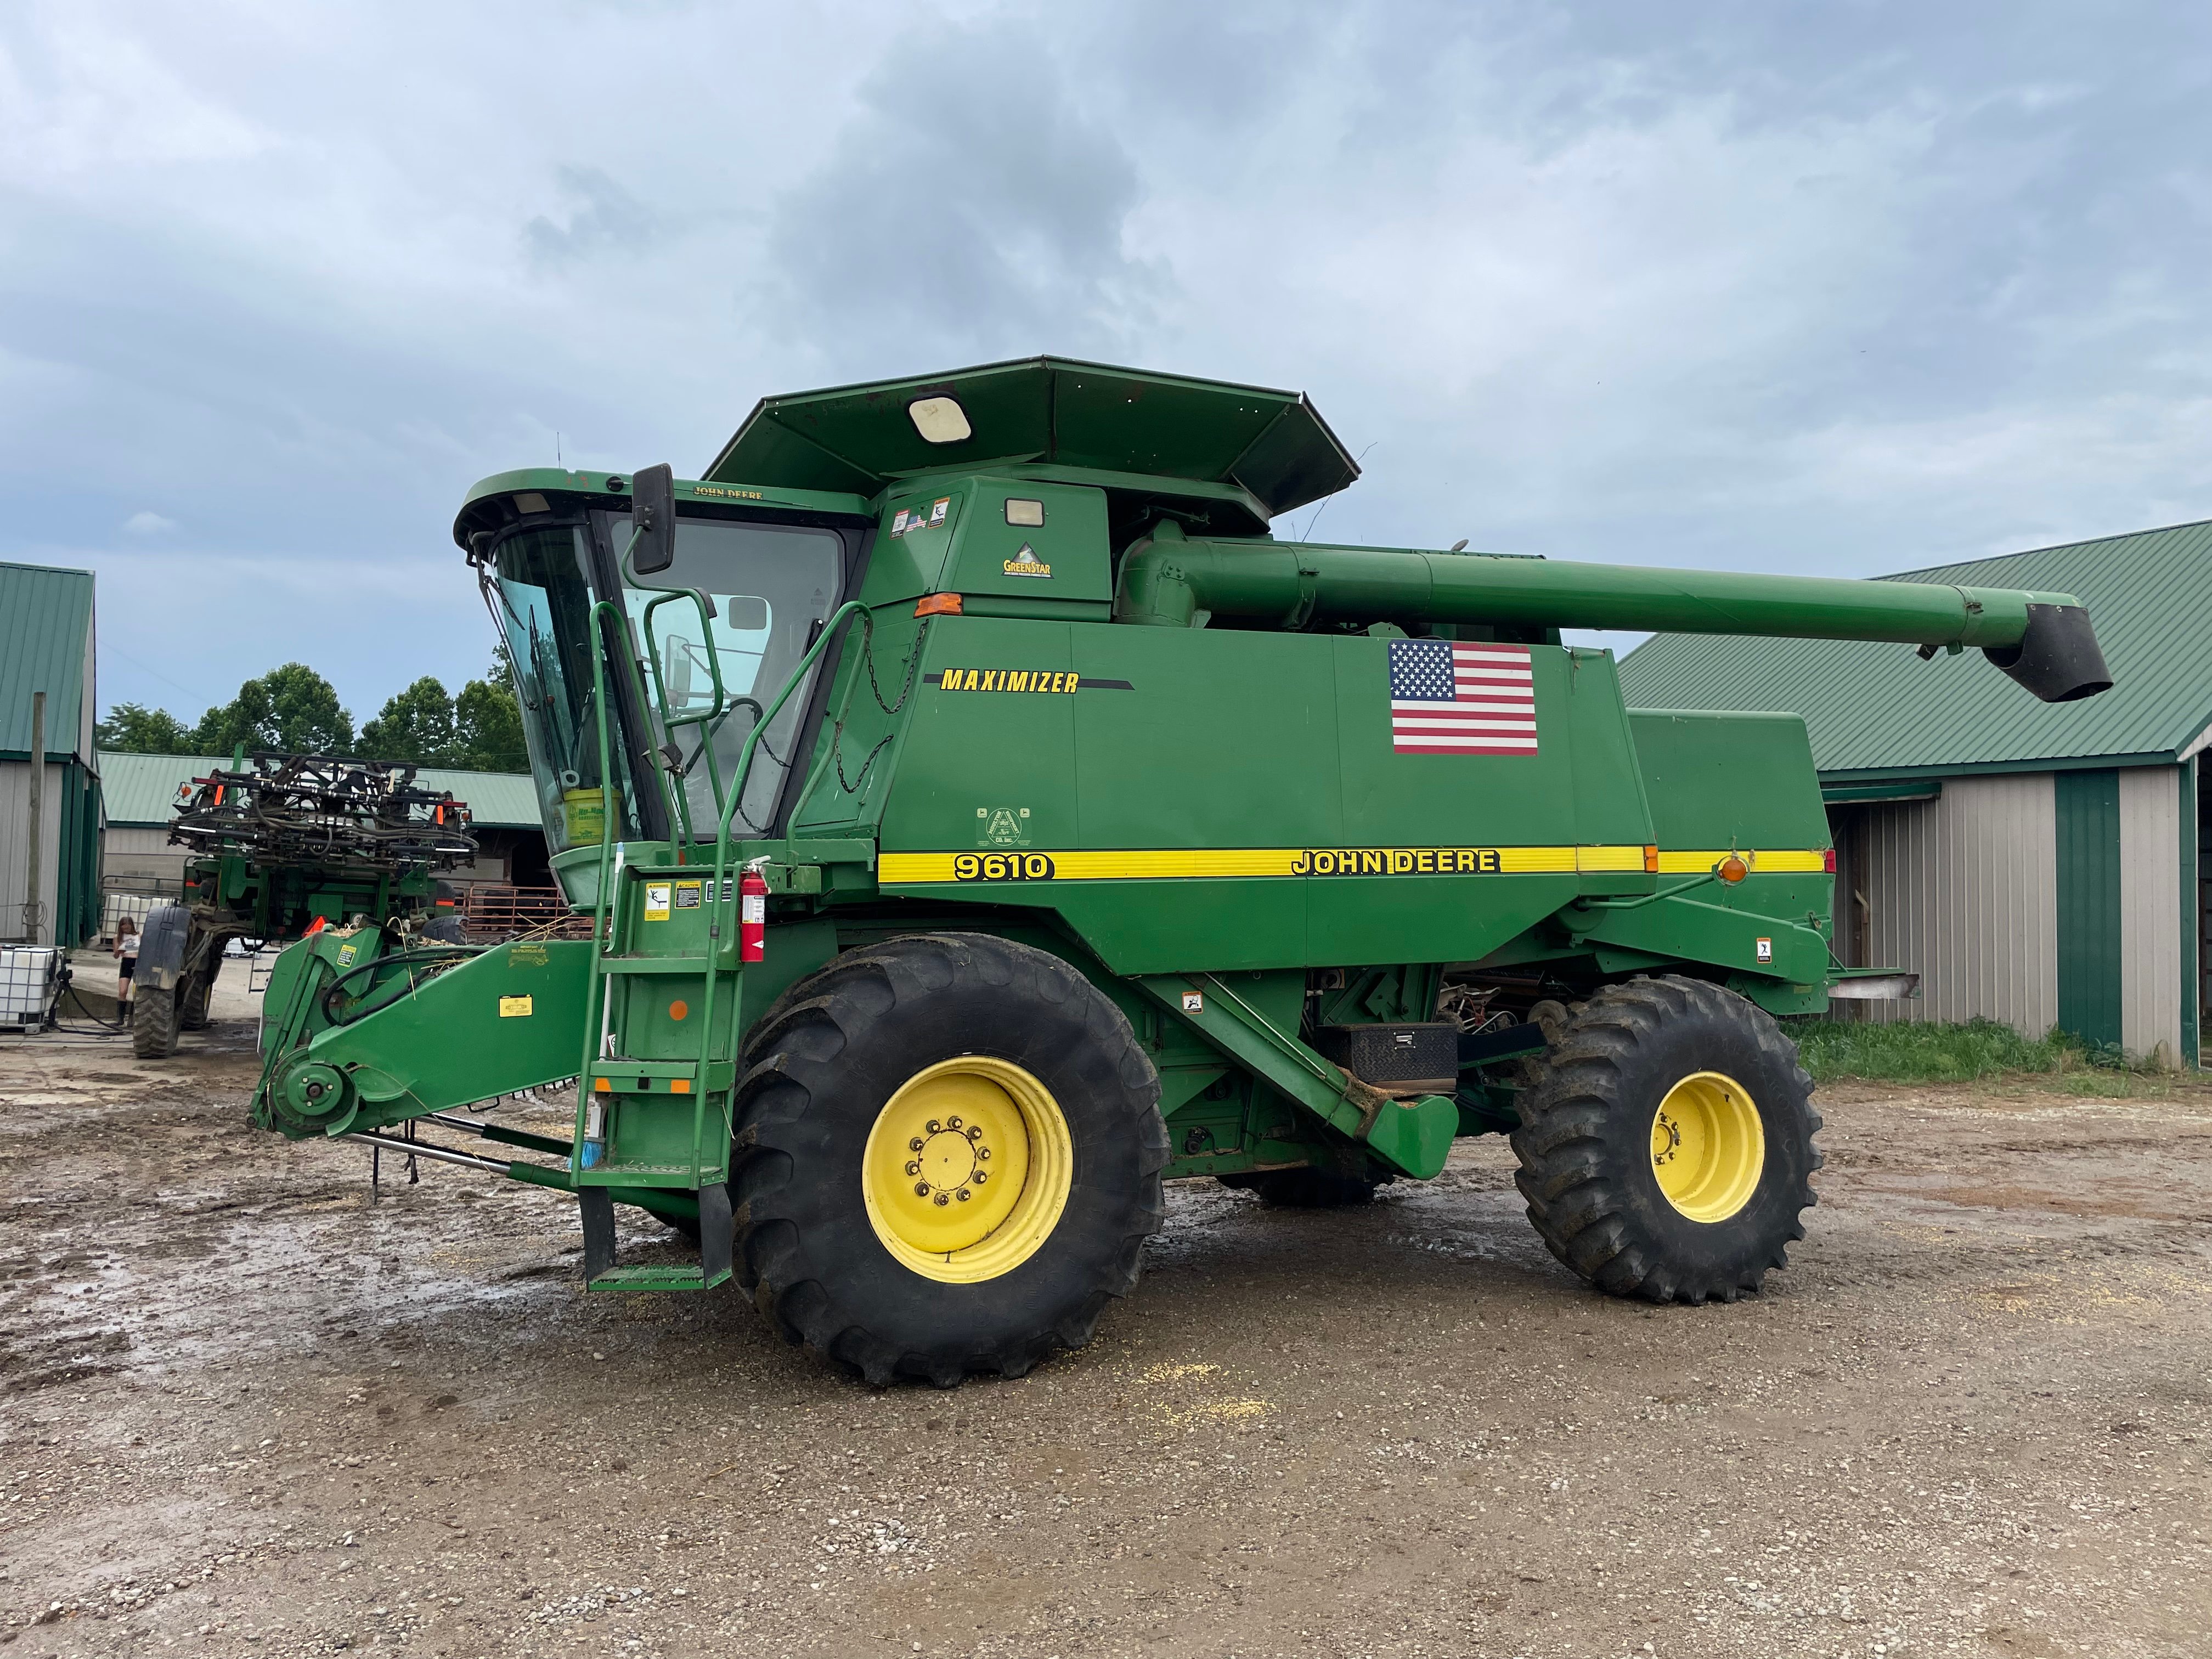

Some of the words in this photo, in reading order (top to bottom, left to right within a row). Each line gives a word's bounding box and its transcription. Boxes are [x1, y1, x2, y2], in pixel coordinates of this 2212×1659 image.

[694, 487, 724, 497] JOHN
[727, 490, 763, 500] DEERE
[940, 669, 1079, 693] MAXIMIZER
[988, 810, 1002, 834] MOULTON
[955, 854, 1051, 879] 9610
[1291, 851, 1385, 874] JOHN
[1393, 850, 1499, 873] DEERE
